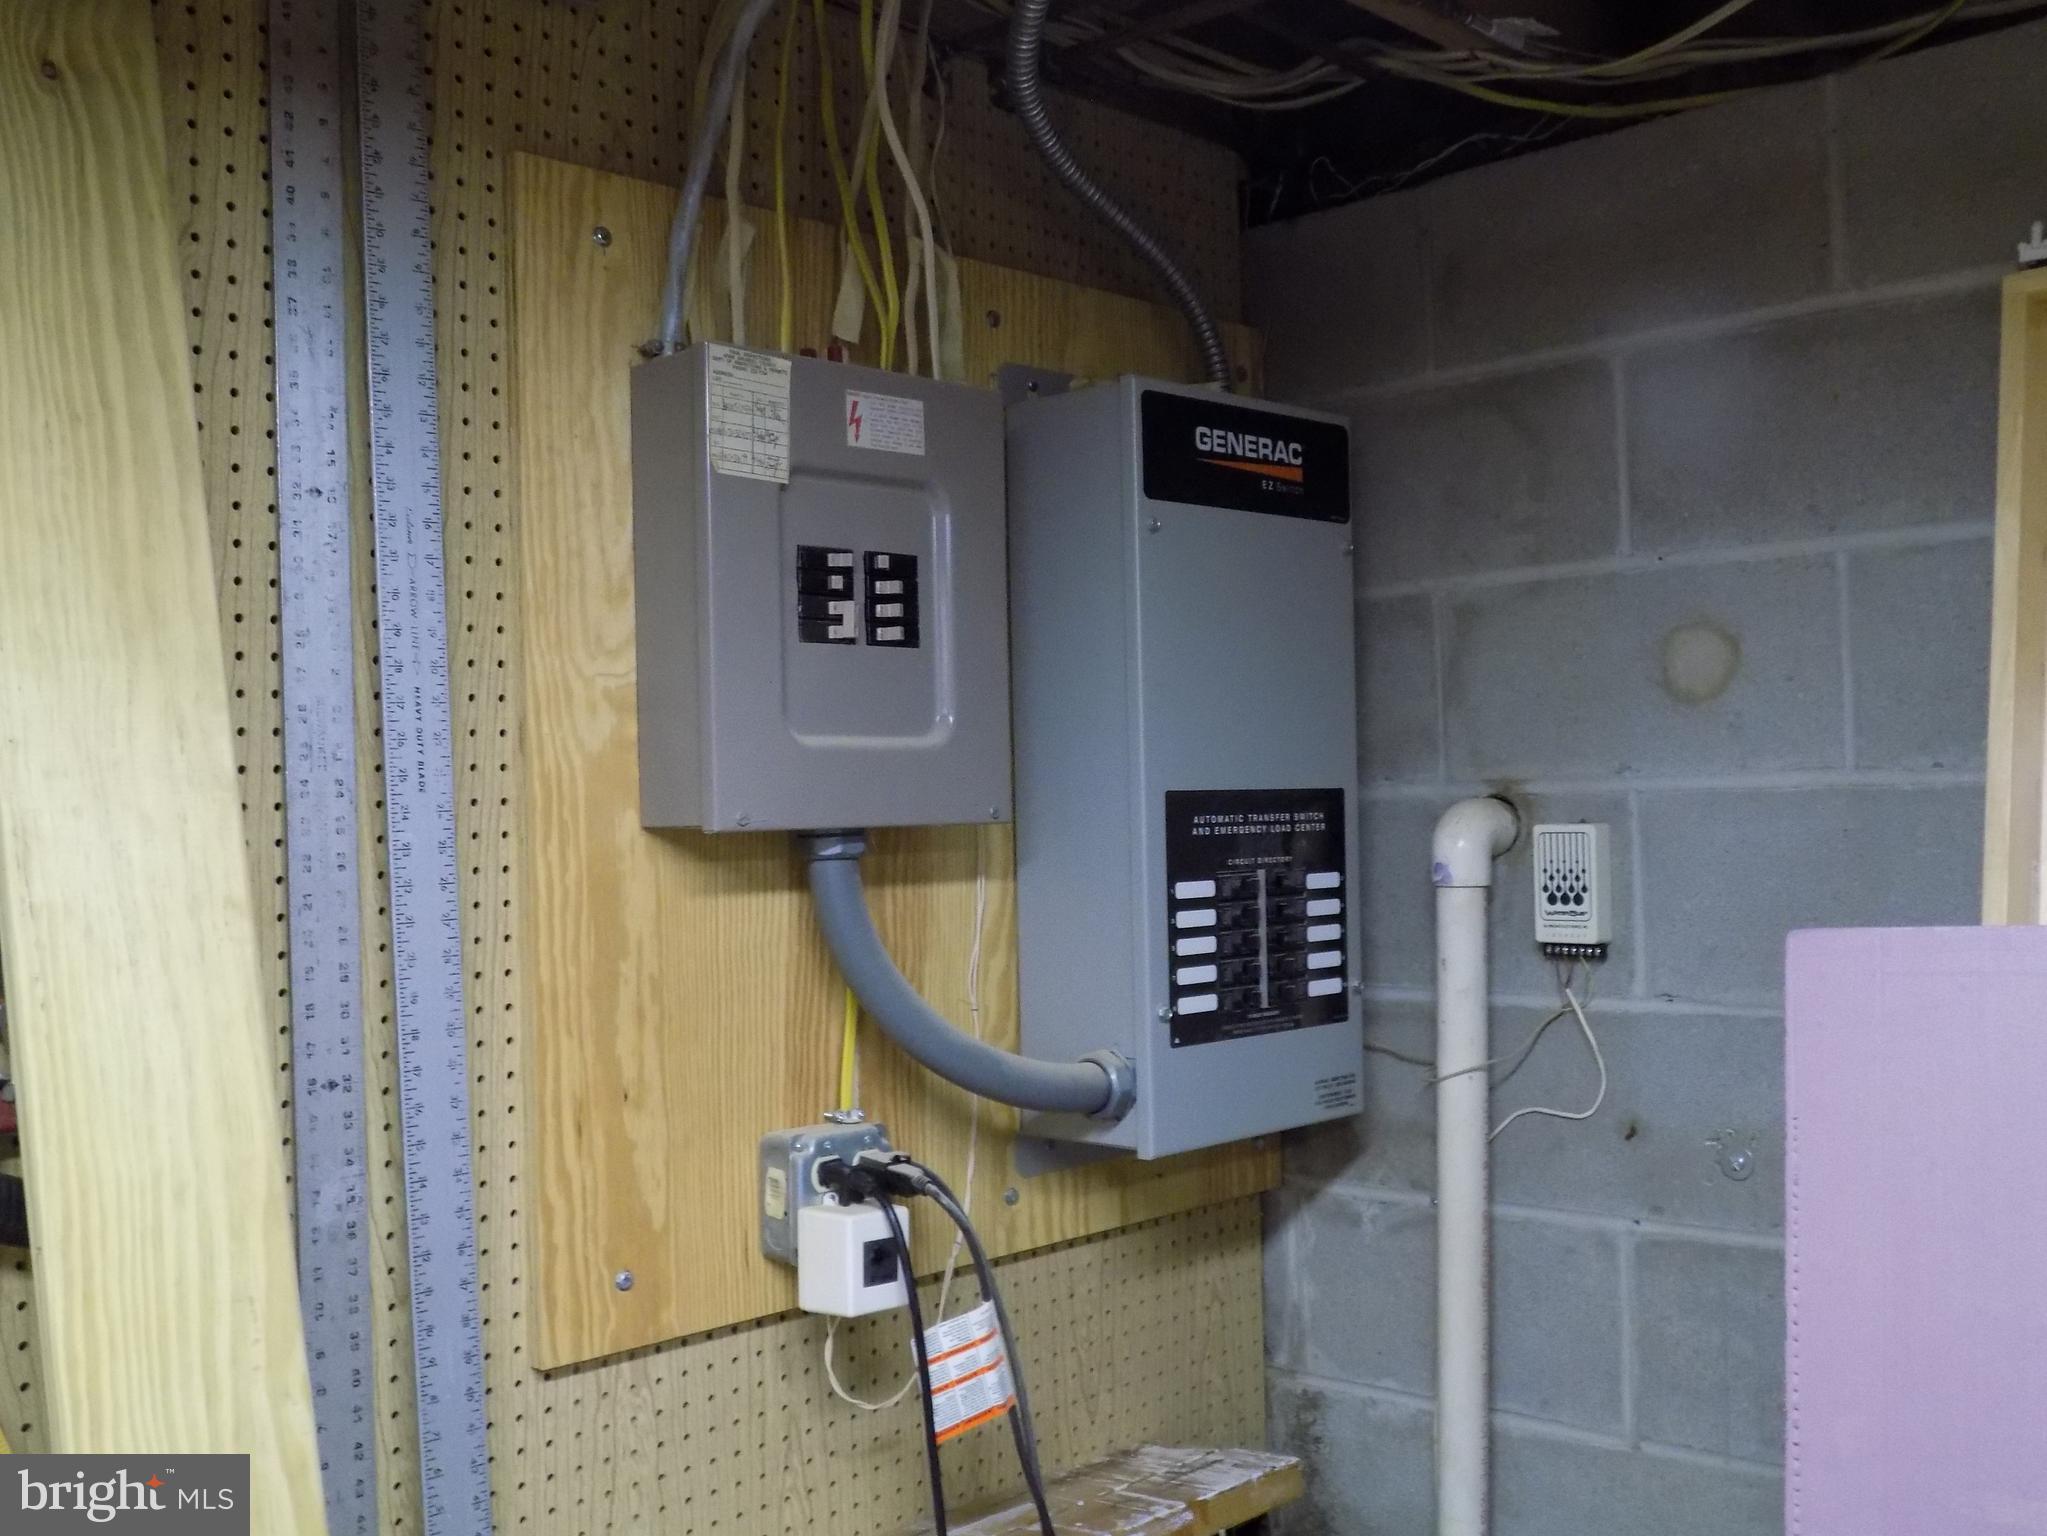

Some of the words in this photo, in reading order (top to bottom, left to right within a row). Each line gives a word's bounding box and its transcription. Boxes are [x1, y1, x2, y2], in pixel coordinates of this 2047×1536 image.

[285, 149, 295, 168] 41
[286, 185, 296, 205] 40
[321, 191, 329, 199] 8
[287, 259, 298, 278] 38
[1195, 426, 1303, 465] GENERAC
[292, 482, 303, 501] 32
[1262, 480, 1273, 491] EZ
[408, 577, 418, 618] ARROW
[413, 686, 423, 722] HEAVY
[415, 728, 425, 755] DUTY
[417, 760, 426, 793] BLADE
[1193, 815, 1244, 824] AUTOMATIC
[1248, 813, 1291, 822] TRANSFER
[1294, 812, 1324, 821] SWITCH
[1192, 827, 1210, 836] AND
[1214, 825, 1267, 835] EMERGENCY
[1270, 824, 1292, 833] LOAD
[1294, 822, 1326, 832] CENTER
[302, 854, 312, 874] 22
[336, 852, 346, 872] 26
[303, 893, 313, 911] 21
[340, 1001, 350, 1019] 30
[307, 1078, 318, 1096] 16
[342, 1074, 353, 1094] 32
[344, 1110, 354, 1130] 33
[344, 1148, 355, 1167] 34
[348, 1258, 358, 1276] 37
[315, 1302, 325, 1321] 10
[315, 1351, 326, 1360] 9
[353, 1406, 363, 1423] 41
[317, 1425, 327, 1434] 7
[354, 1442, 363, 1461] 42
